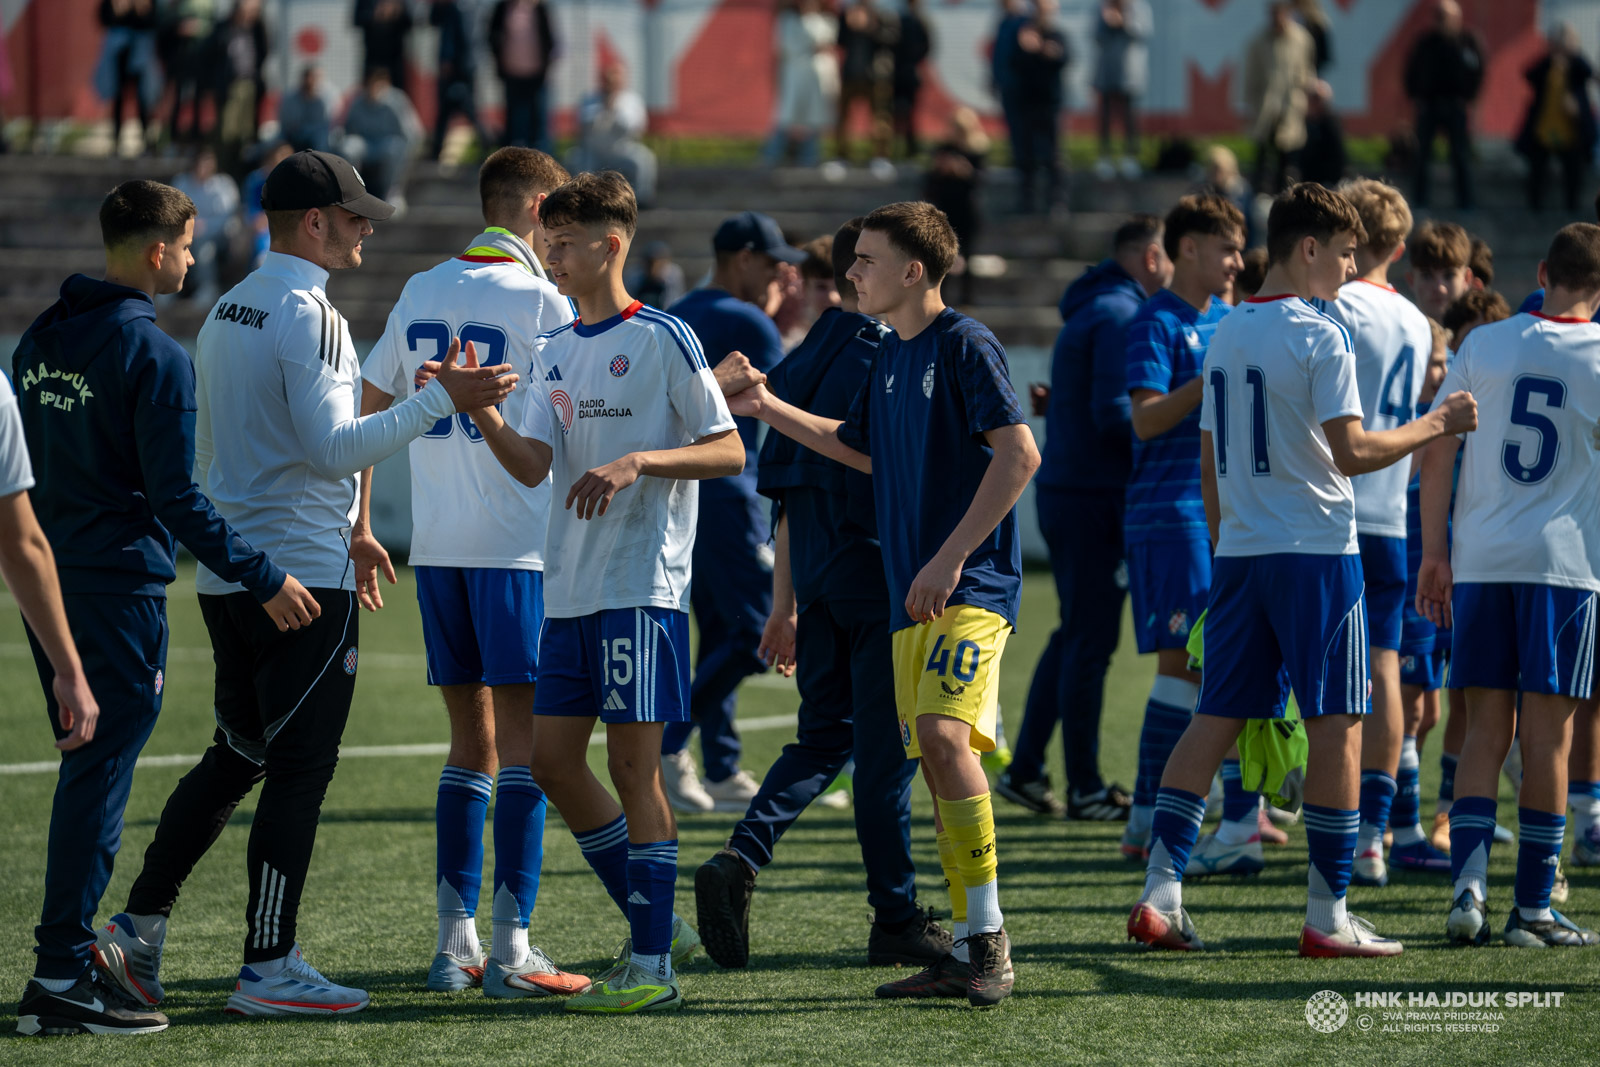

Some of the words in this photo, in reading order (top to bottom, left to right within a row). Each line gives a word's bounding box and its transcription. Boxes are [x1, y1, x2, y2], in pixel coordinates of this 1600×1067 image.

[40, 390, 75, 412] SPLIT
[579, 399, 605, 409] RADIO
[1378, 342, 1416, 427] 4
[578, 408, 632, 419] DALMACIJA
[1210, 364, 1271, 478] 11
[1501, 372, 1568, 486] 5
[602, 637, 633, 686] 15
[926, 634, 980, 682] 40
